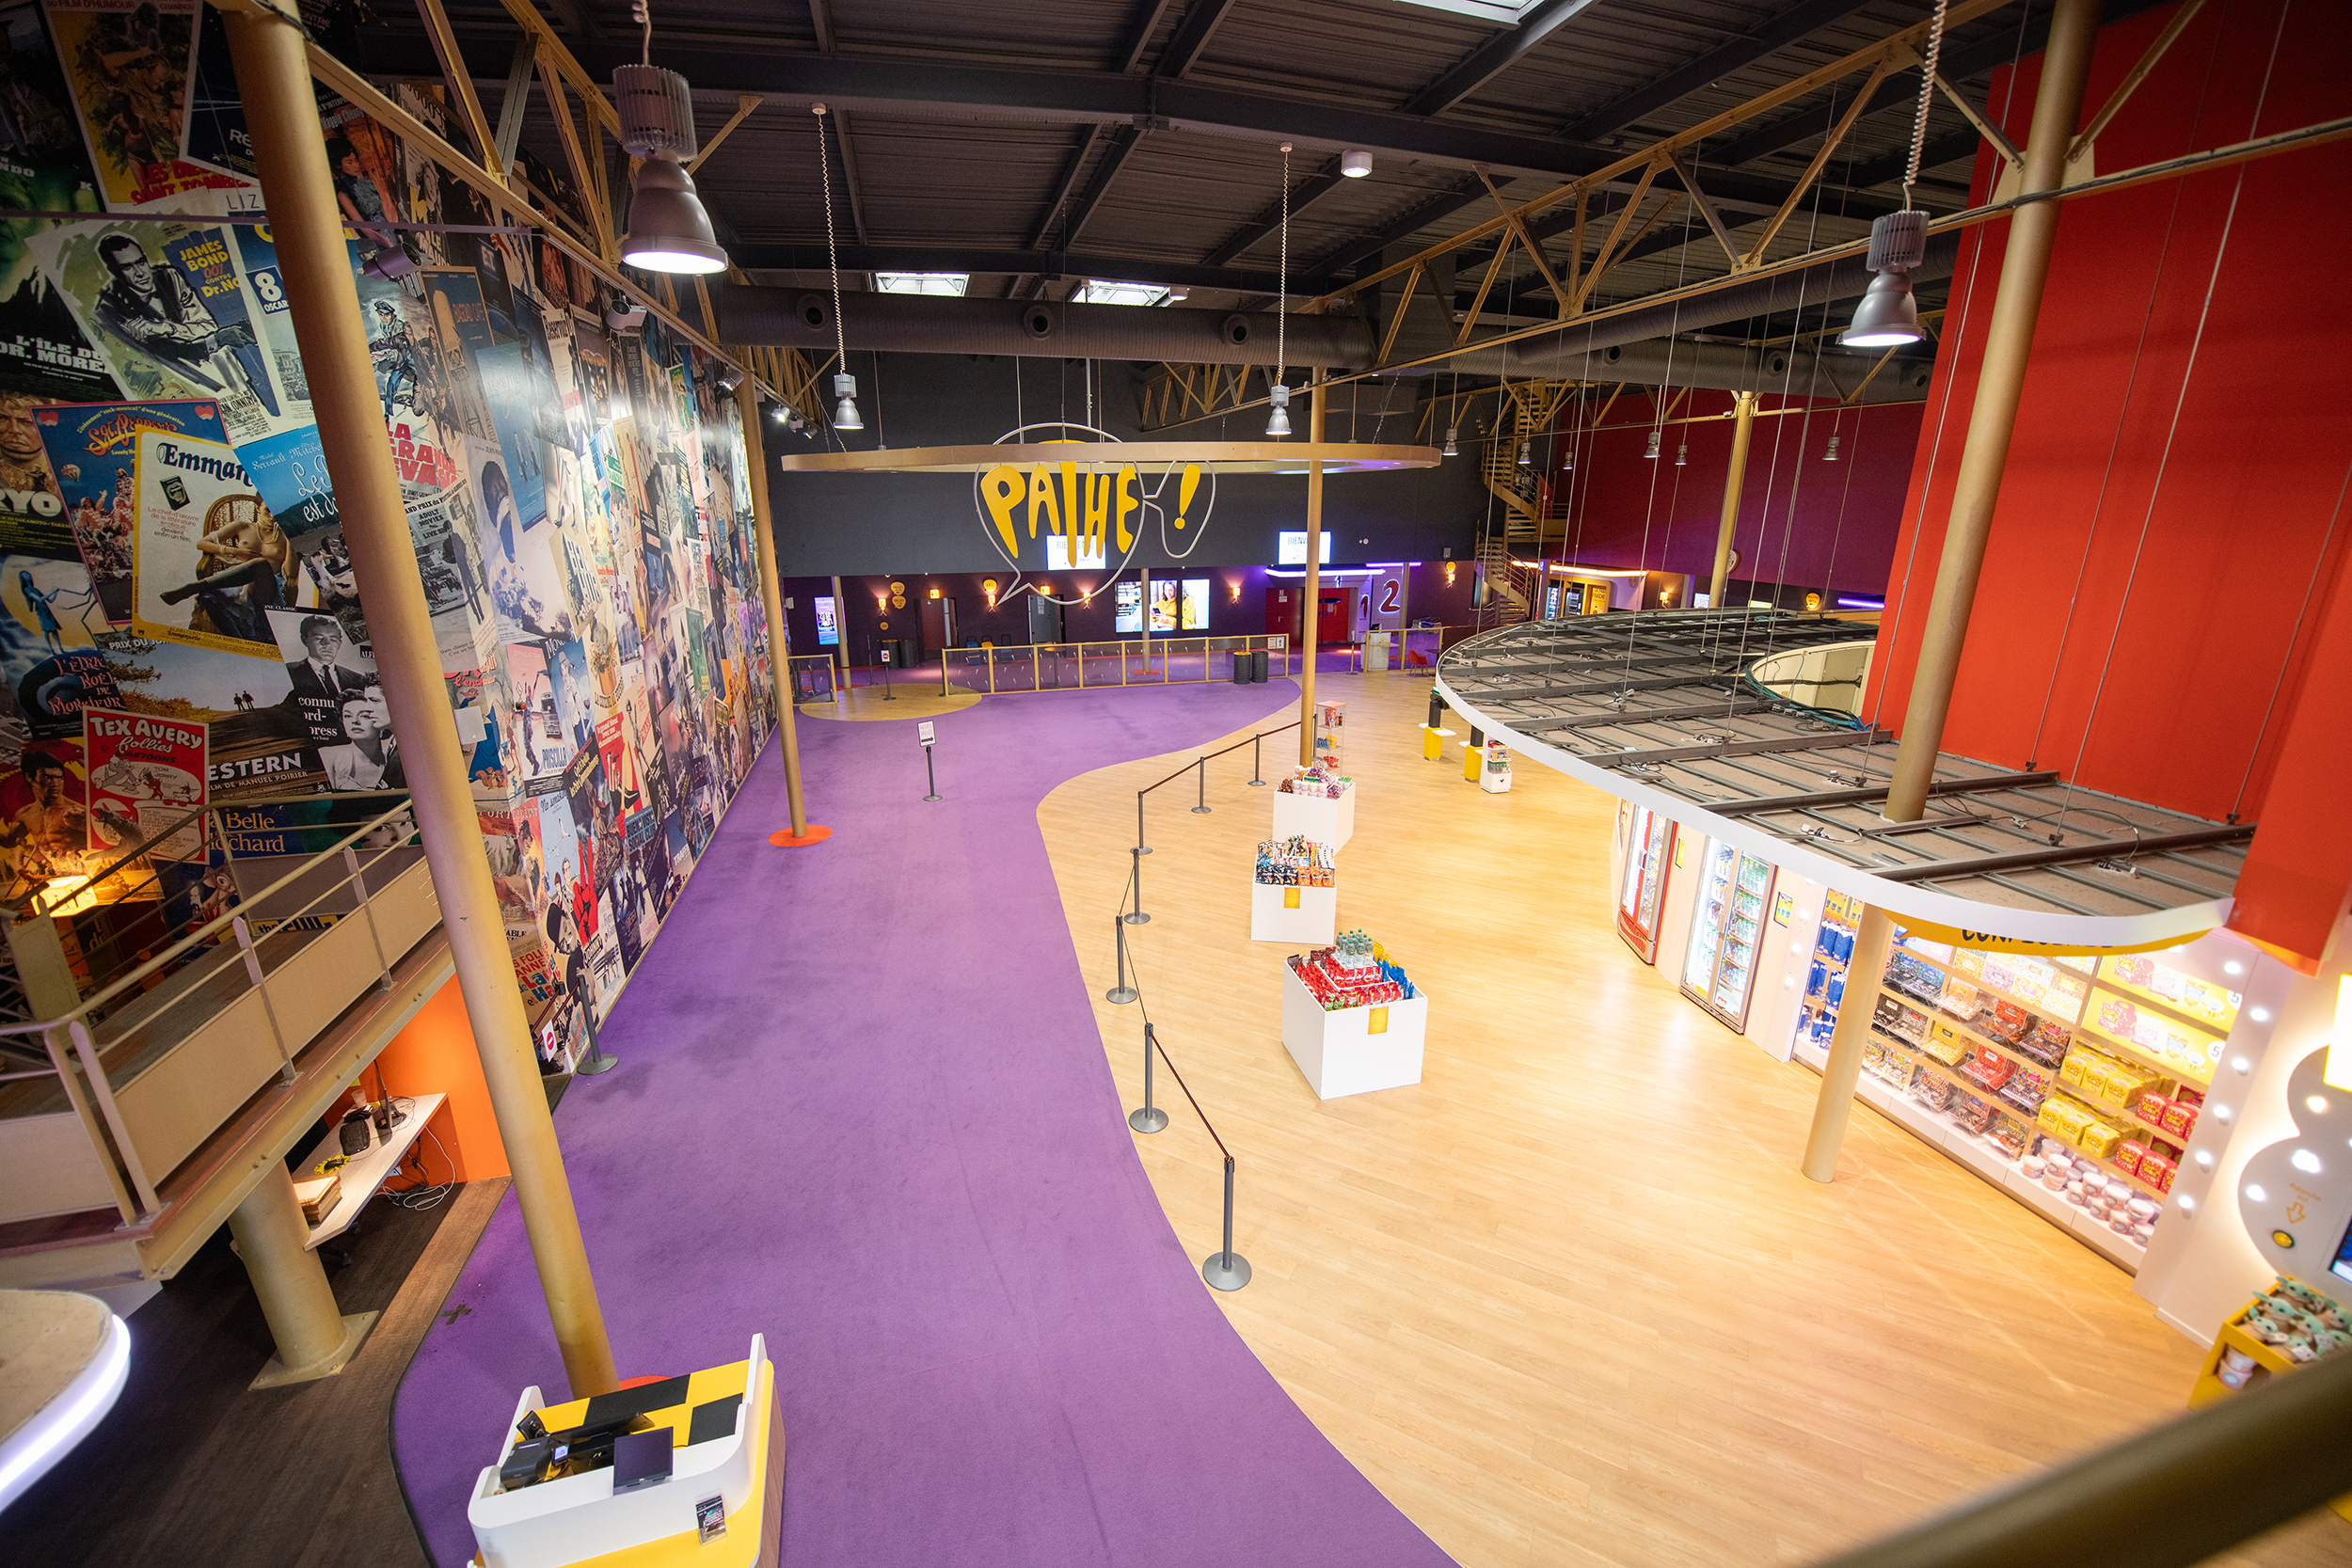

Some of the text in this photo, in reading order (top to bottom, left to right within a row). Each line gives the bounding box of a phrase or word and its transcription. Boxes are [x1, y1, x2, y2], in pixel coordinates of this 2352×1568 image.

[141, 163, 169, 184] LES
[180, 240, 223, 262] JAMES
[186, 250, 229, 272] BOND
[204, 263, 224, 278] 007
[205, 273, 231, 284] CONTRE
[254, 272, 282, 302] 8
[303, 496, 325, 522] est
[418, 501, 433, 511] PRIX
[419, 509, 439, 519] ADULT
[419, 515, 444, 527] MOVIES
[422, 530, 437, 539] LIVE
[1378, 578, 1401, 613] 2
[109, 639, 148, 650] PRIX DU
[96, 687, 112, 695] DE
[89, 717, 132, 737] TEX
[135, 719, 203, 750] AVERY
[115, 736, 173, 753] follies
[115, 750, 177, 764] CARTOONS
[209, 752, 302, 782] ESTERN
[238, 776, 275, 787] MANUEL
[275, 771, 309, 782] POIRIER
[226, 812, 275, 830] Belle
